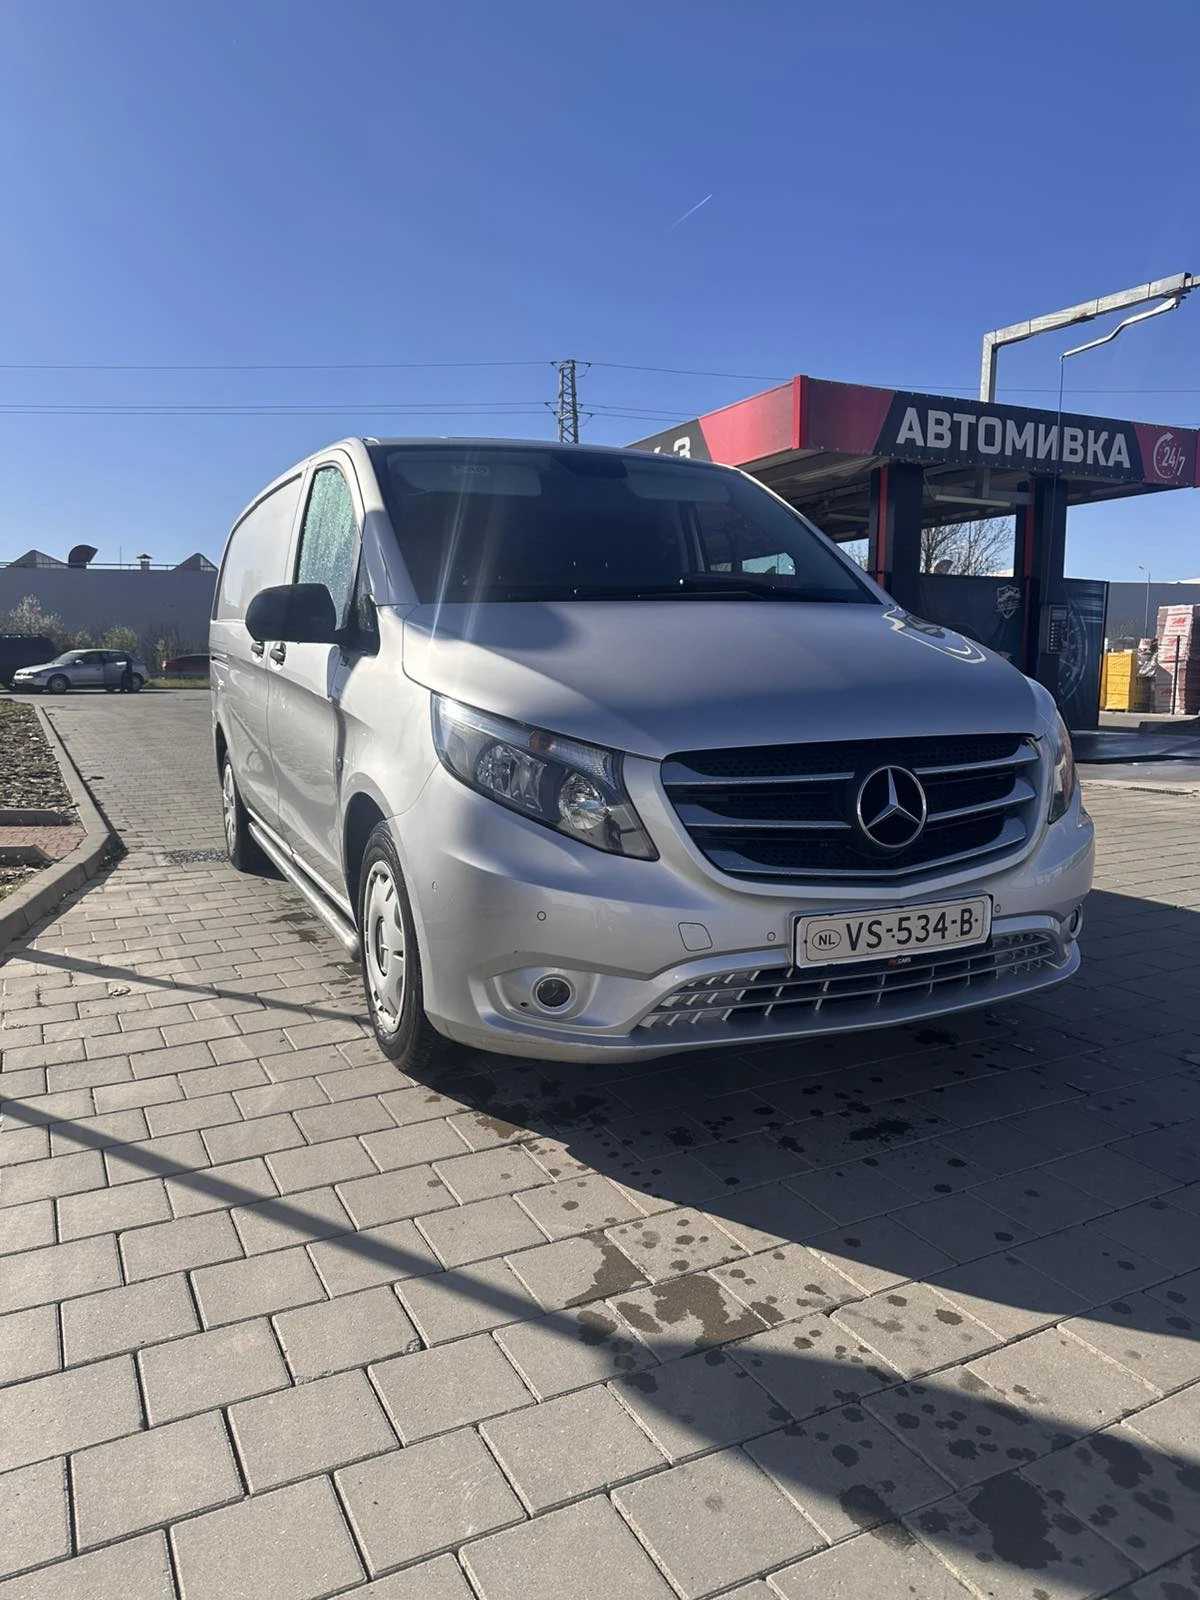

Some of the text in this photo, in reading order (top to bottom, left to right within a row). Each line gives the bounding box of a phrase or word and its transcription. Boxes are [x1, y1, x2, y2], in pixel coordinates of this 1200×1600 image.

[896, 407, 1131, 469] АВТОМИВКА
[1162, 446, 1186, 476] 24/7
[818, 908, 973, 951] NL VS-534-B
